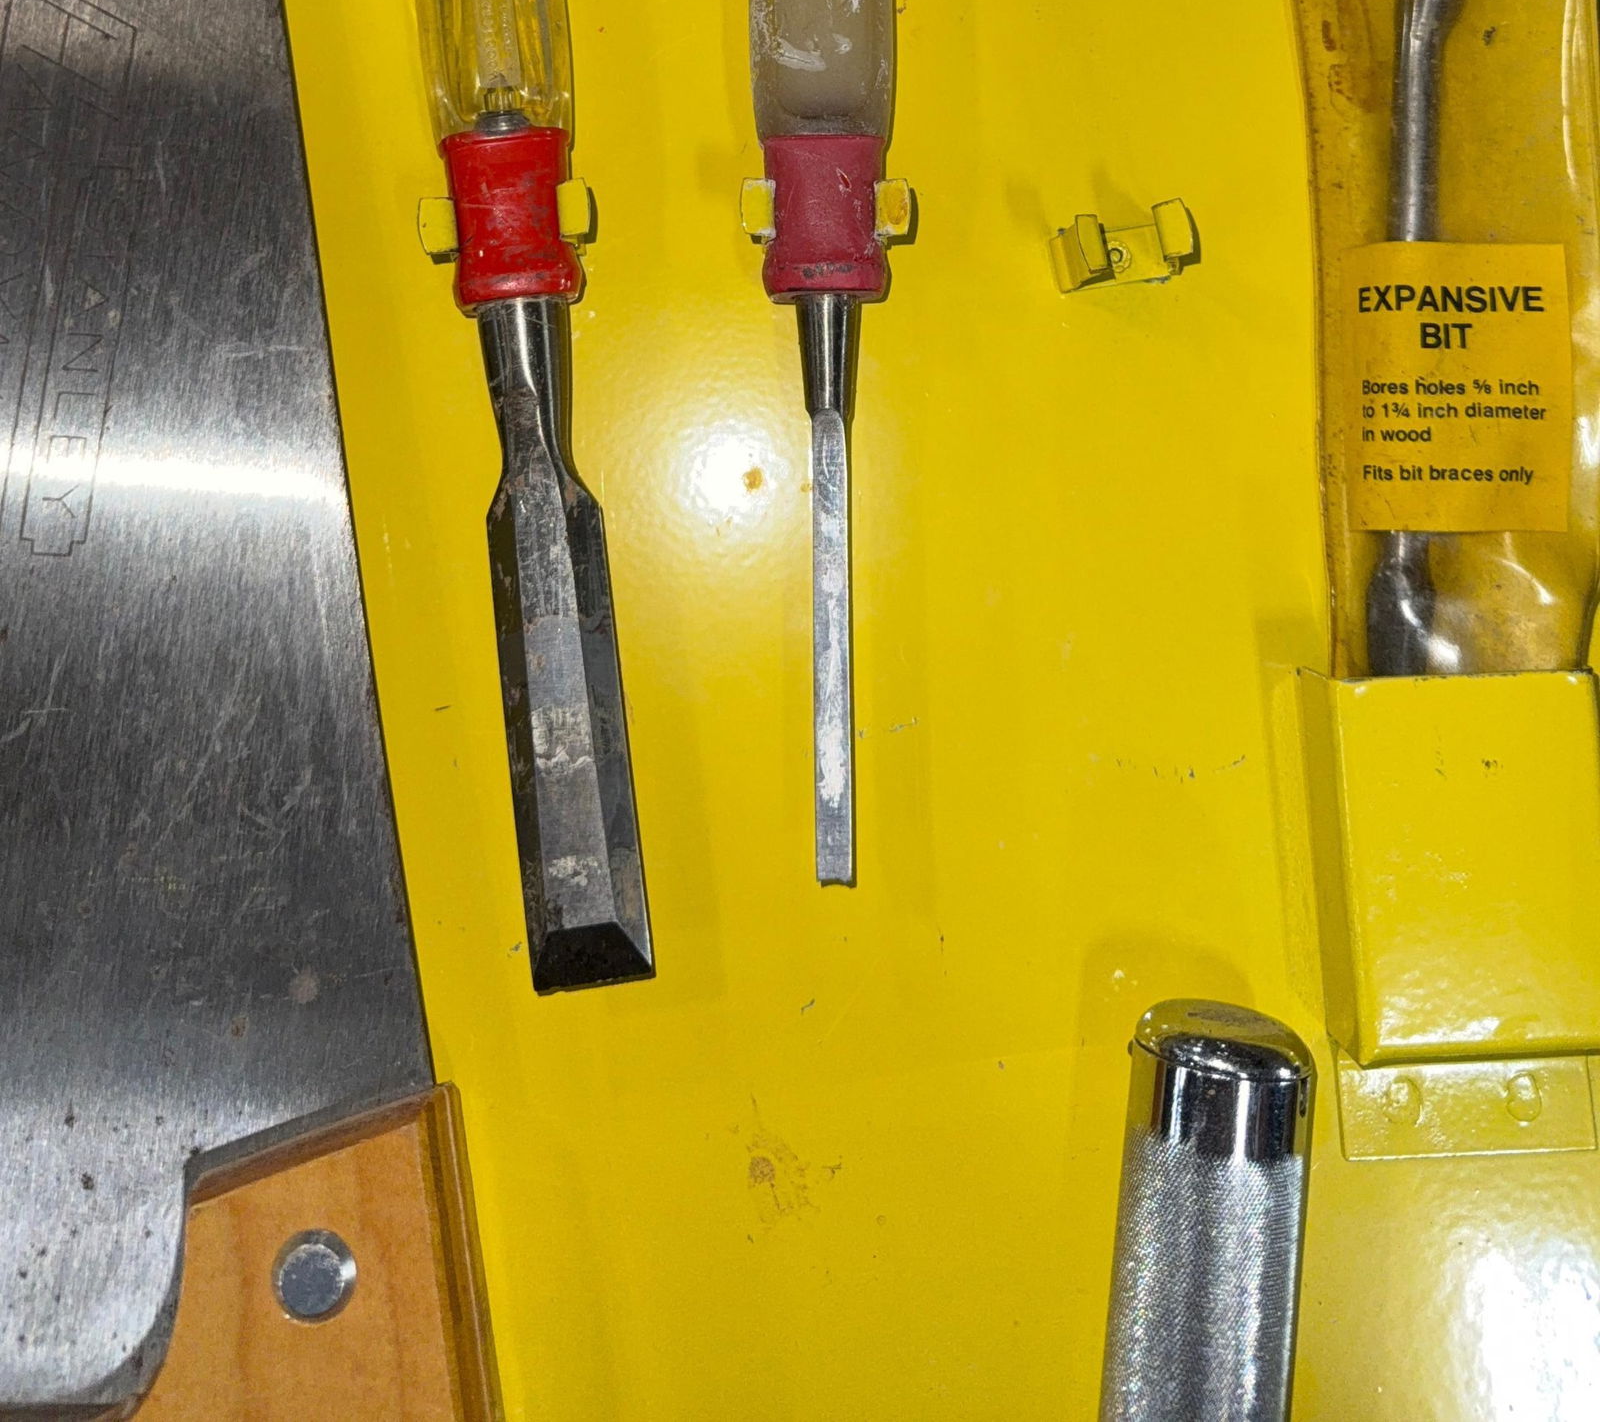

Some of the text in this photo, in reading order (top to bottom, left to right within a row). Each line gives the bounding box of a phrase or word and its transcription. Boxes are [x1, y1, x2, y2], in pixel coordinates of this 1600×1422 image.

[1358, 284, 1545, 313] EXPANSIVE
[1420, 322, 1473, 350] BIT
[1362, 379, 1409, 396] Bores
[1415, 379, 1466, 396] holes
[1499, 379, 1540, 396] inch
[1362, 404, 1375, 419] to
[1417, 402, 1459, 419] inch
[1464, 403, 1547, 420] diameter
[1362, 426, 1432, 442] in wood
[1363, 464, 1534, 485] Fits bit braces only
